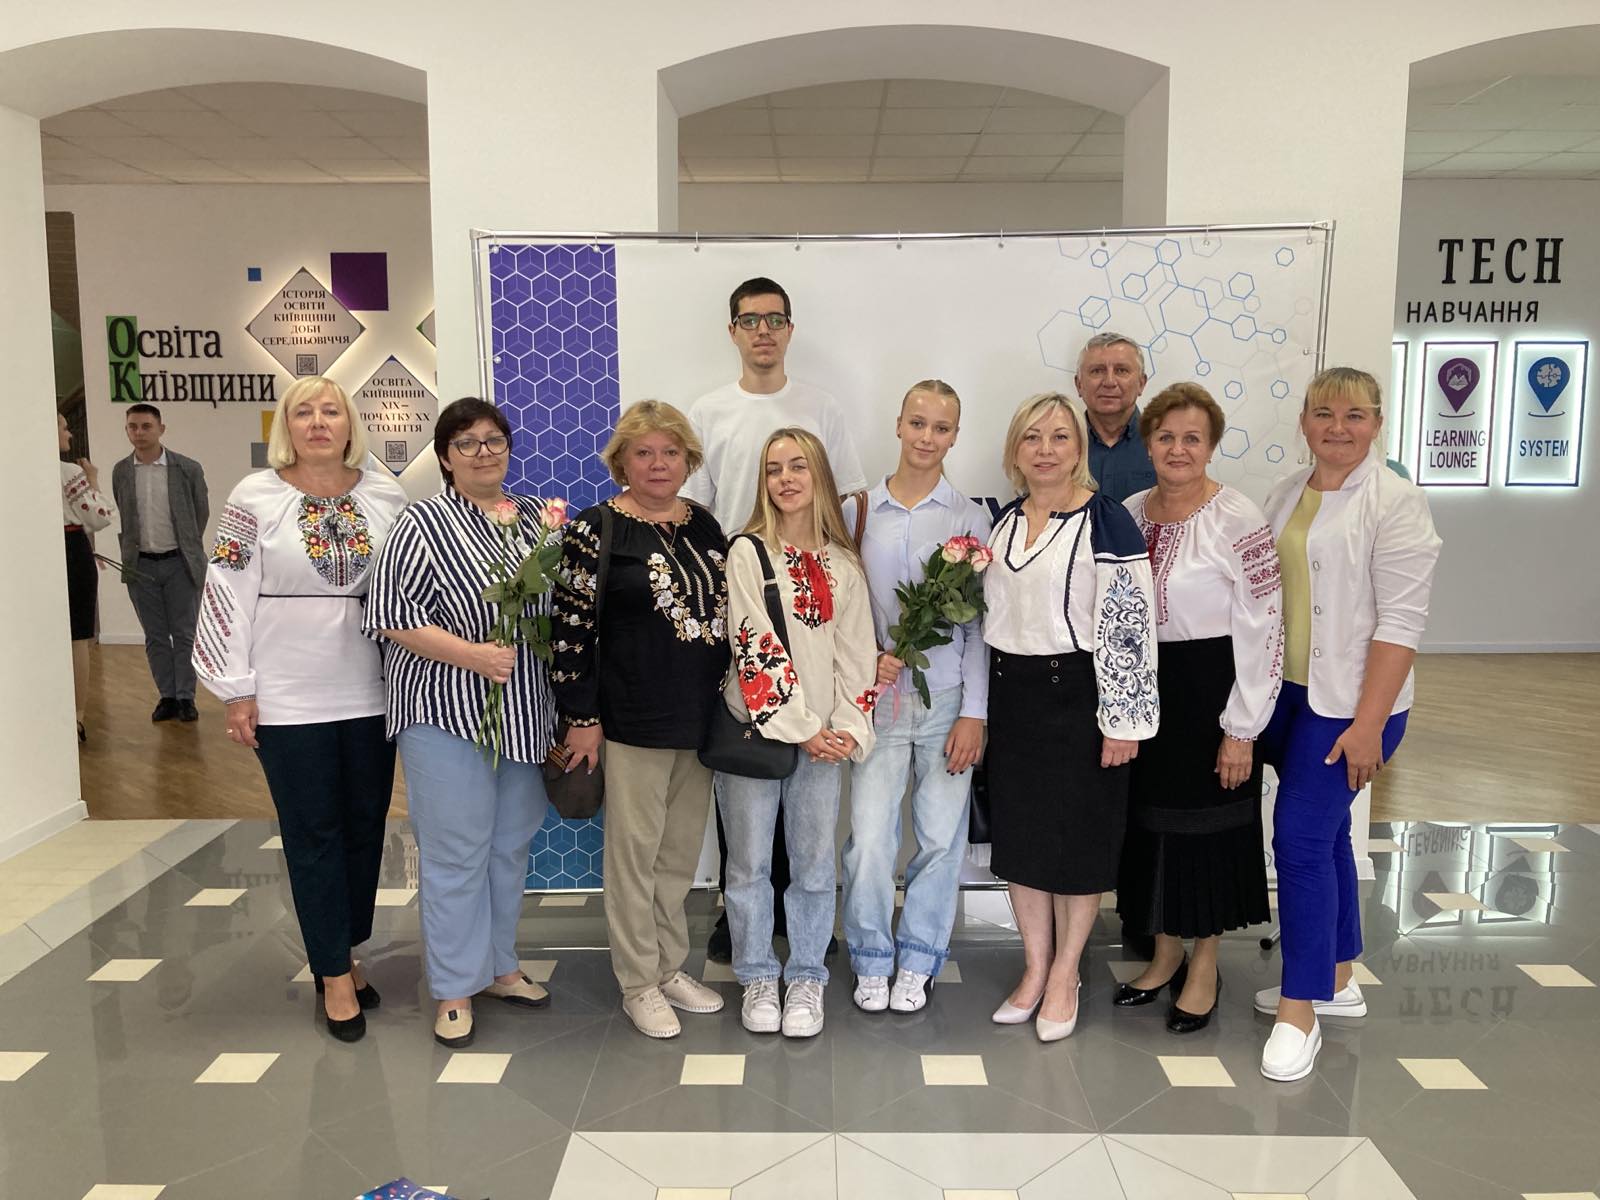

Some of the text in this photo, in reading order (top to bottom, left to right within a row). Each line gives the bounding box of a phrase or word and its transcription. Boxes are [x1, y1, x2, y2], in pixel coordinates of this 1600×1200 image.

[1438, 238, 1564, 284] TECH
[282, 290, 326, 299] ІСТОРІЯ
[283, 301, 325, 310] ОСВІТИ
[1406, 300, 1539, 323] НАВЧАННЯ
[274, 312, 336, 322] КИЇВЩИНИ
[291, 325, 321, 334] ДОБИ
[108, 317, 223, 359] Освіта
[262, 336, 350, 346] СЕРЕДНЬОВІЧЧЯ
[109, 361, 277, 408] Київщини
[372, 378, 412, 386] ОСВІТА
[362, 389, 425, 398] КИЇВЩИНИ
[367, 424, 422, 432] СТОЛІТТЯ
[1426, 430, 1486, 447] LEARNING
[1519, 440, 1569, 457] SYSTEM
[1429, 451, 1478, 468] LOUNGE
